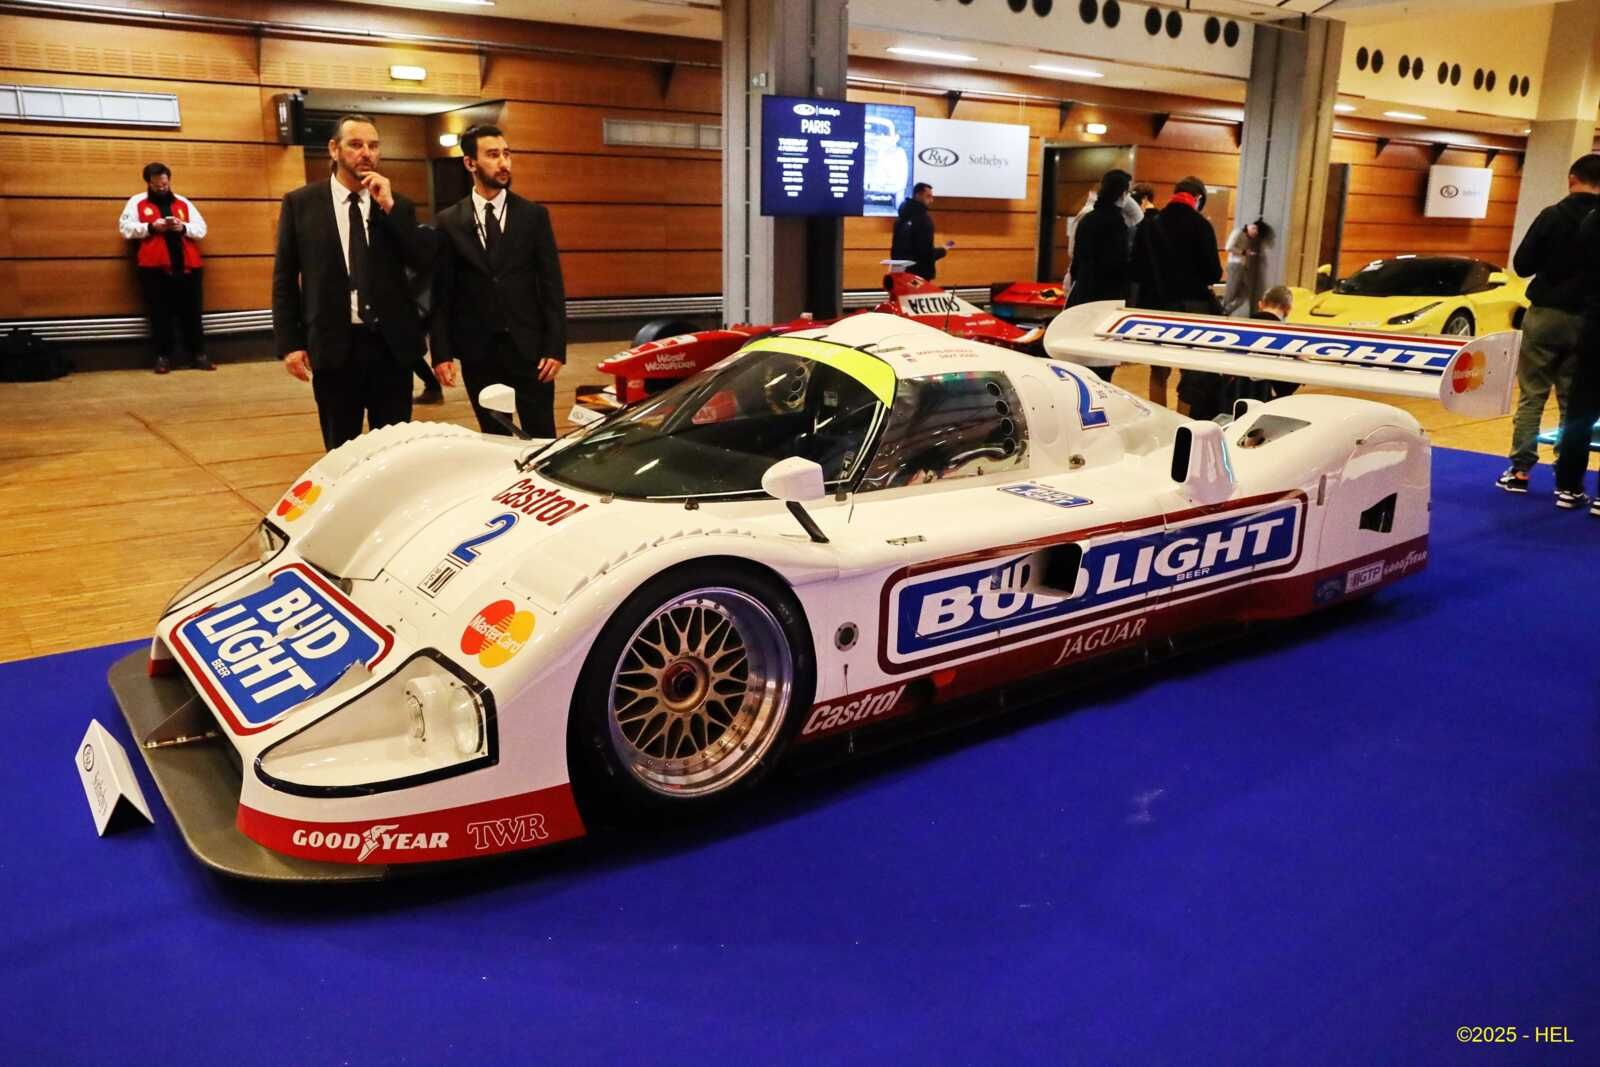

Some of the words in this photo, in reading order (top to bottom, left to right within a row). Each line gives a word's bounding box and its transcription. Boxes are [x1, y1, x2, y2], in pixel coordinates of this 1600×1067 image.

[801, 119, 831, 134] PARIS
[1123, 323, 1240, 347] BUD
[1246, 335, 1450, 368] LIGHT
[1048, 363, 1110, 431] 2
[491, 478, 590, 527] Castrol
[447, 510, 521, 567] 2
[1095, 517, 1285, 595] LIGHT
[1176, 566, 1211, 582] BEER
[256, 587, 350, 660] BUD
[1055, 617, 1149, 663] JAGUAR
[195, 603, 317, 705] LIGHT
[211, 657, 231, 679] BEER
[801, 683, 908, 736] Castrol
[466, 813, 549, 850] TWR
